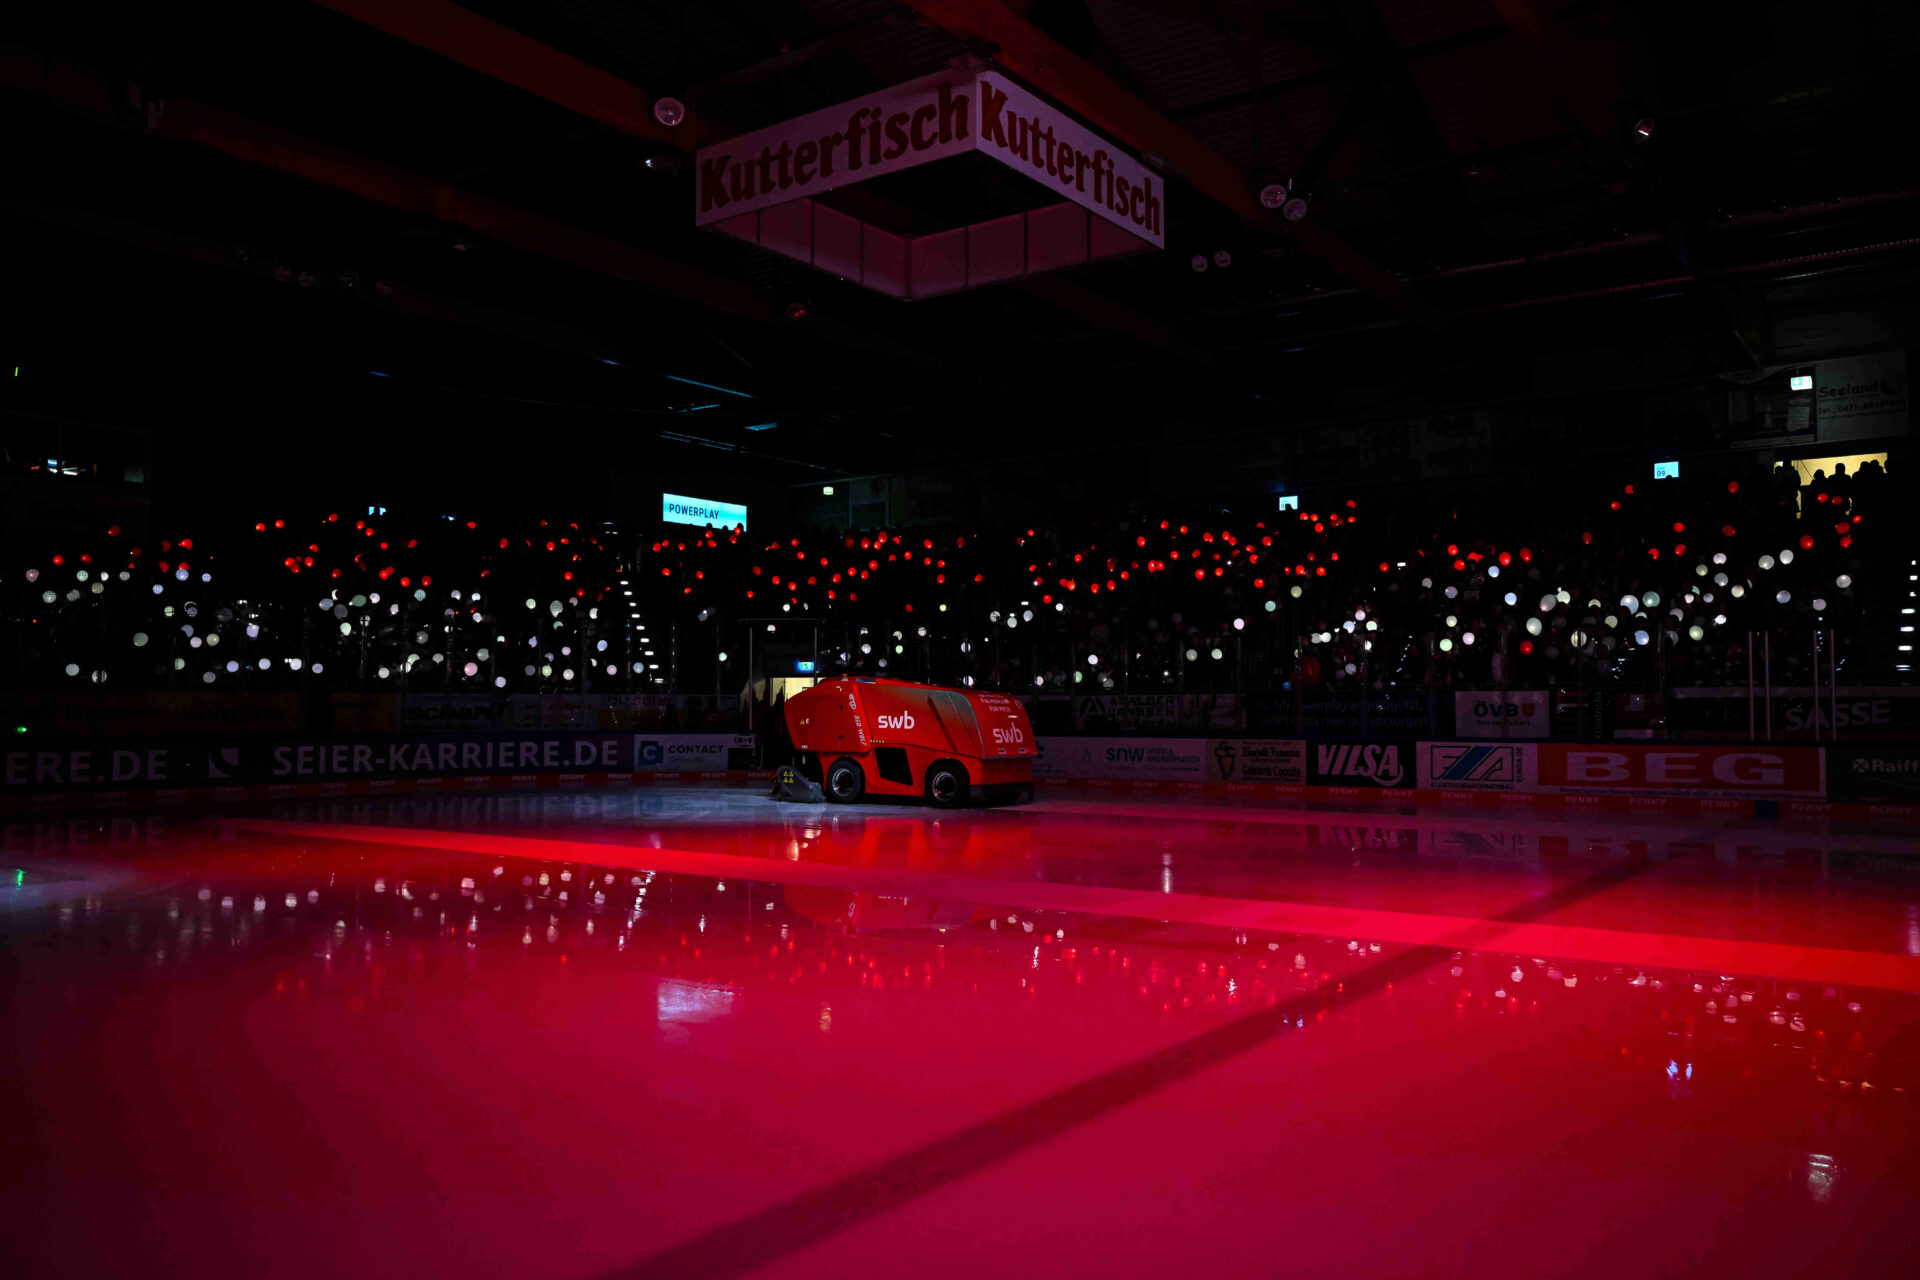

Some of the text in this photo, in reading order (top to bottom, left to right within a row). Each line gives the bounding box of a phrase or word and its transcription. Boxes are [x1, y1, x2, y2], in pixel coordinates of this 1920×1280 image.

[701, 81, 970, 213] Kutterfisch
[981, 81, 1161, 235] Kutterfisch
[1818, 380, 1878, 398] Seeland
[669, 503, 720, 520] POWERPLAY
[877, 710, 916, 730] swb
[1474, 701, 1519, 717] ÖVB
[1785, 699, 1891, 731] SASSE
[992, 721, 1024, 744] swb
[272, 740, 619, 776] SEIER-KARRIERE.DE
[668, 745, 724, 755] CONTACT
[1106, 747, 1145, 762] snw
[5, 748, 168, 785] ERE.DE
[1318, 743, 1404, 787] VILSA
[1565, 751, 1786, 786] BEG
[1700, 800, 1738, 809] PENNY
